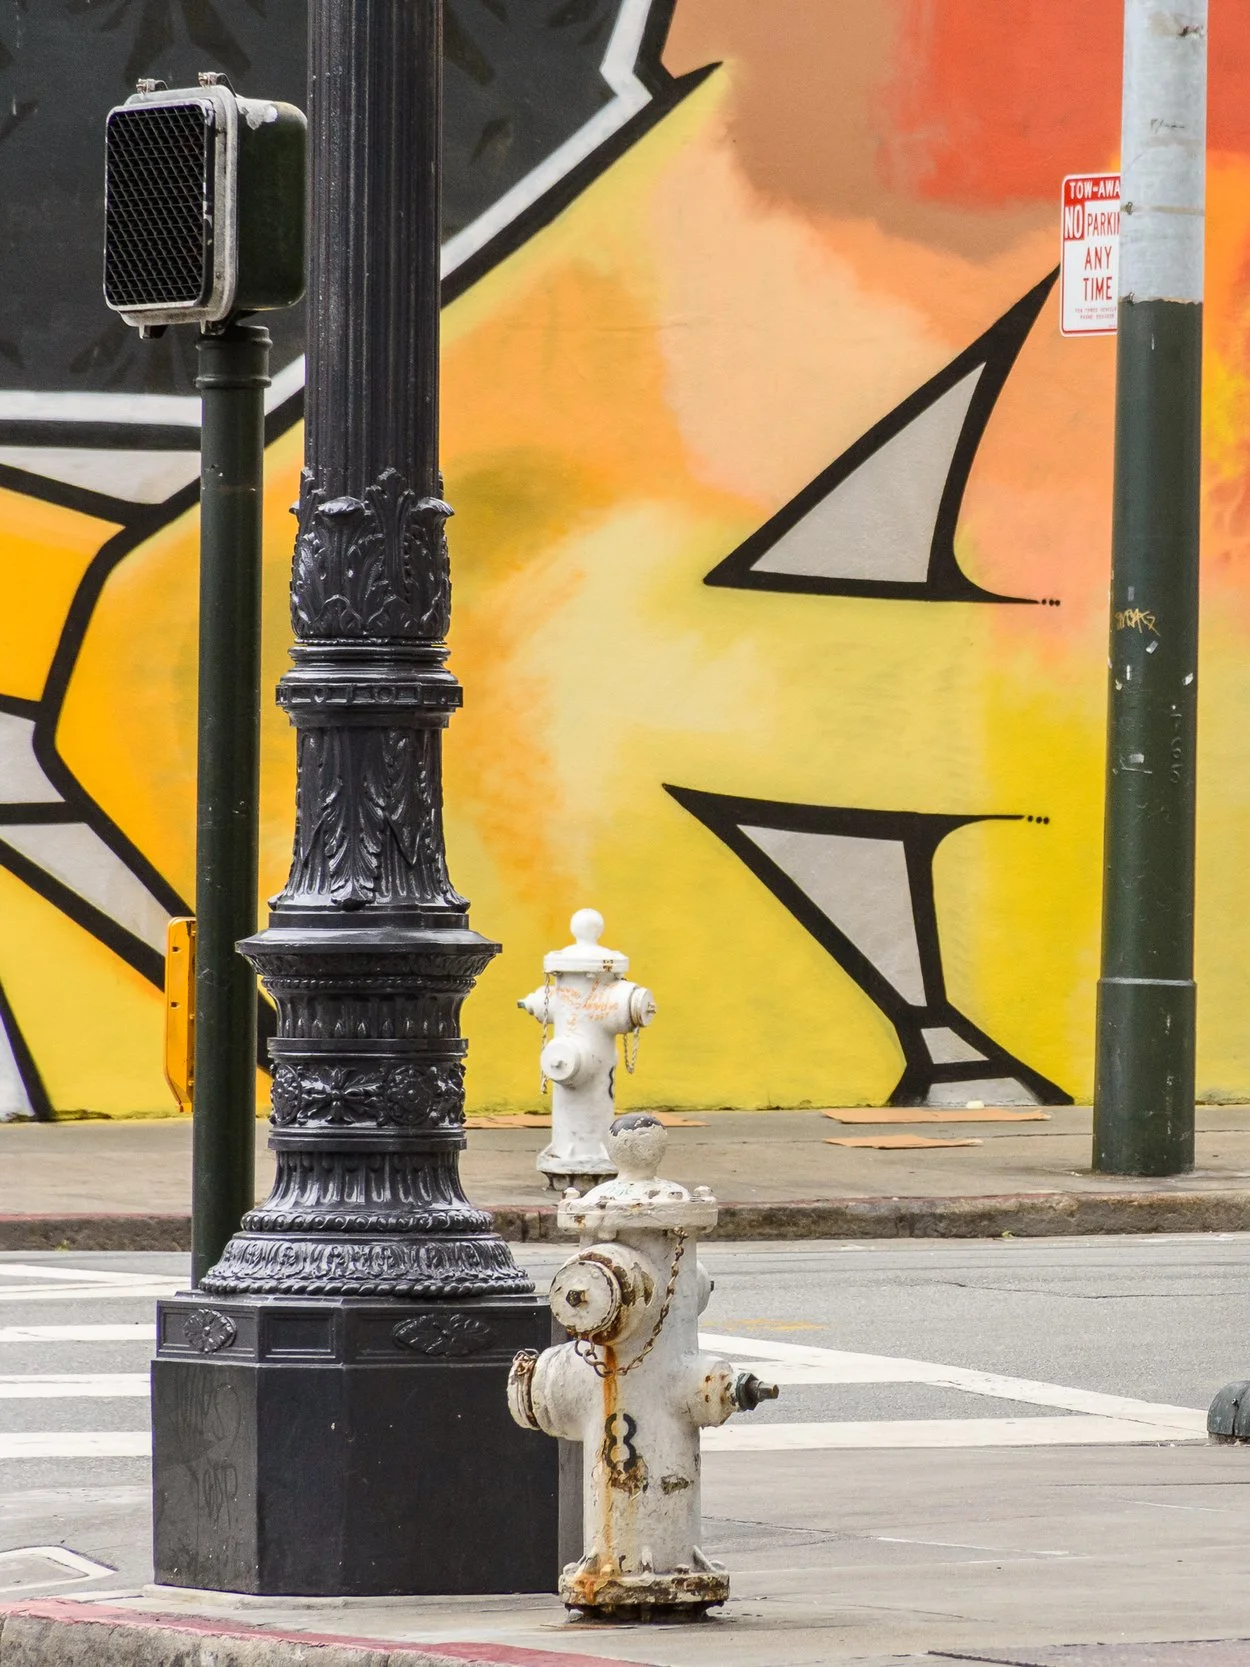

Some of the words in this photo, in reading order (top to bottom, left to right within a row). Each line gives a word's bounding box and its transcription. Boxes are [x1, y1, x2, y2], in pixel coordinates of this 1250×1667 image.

[1069, 180, 1120, 199] TOW-AWA
[1065, 203, 1083, 237] NO
[1084, 246, 1112, 271] ANY
[1083, 277, 1112, 301] TIME
